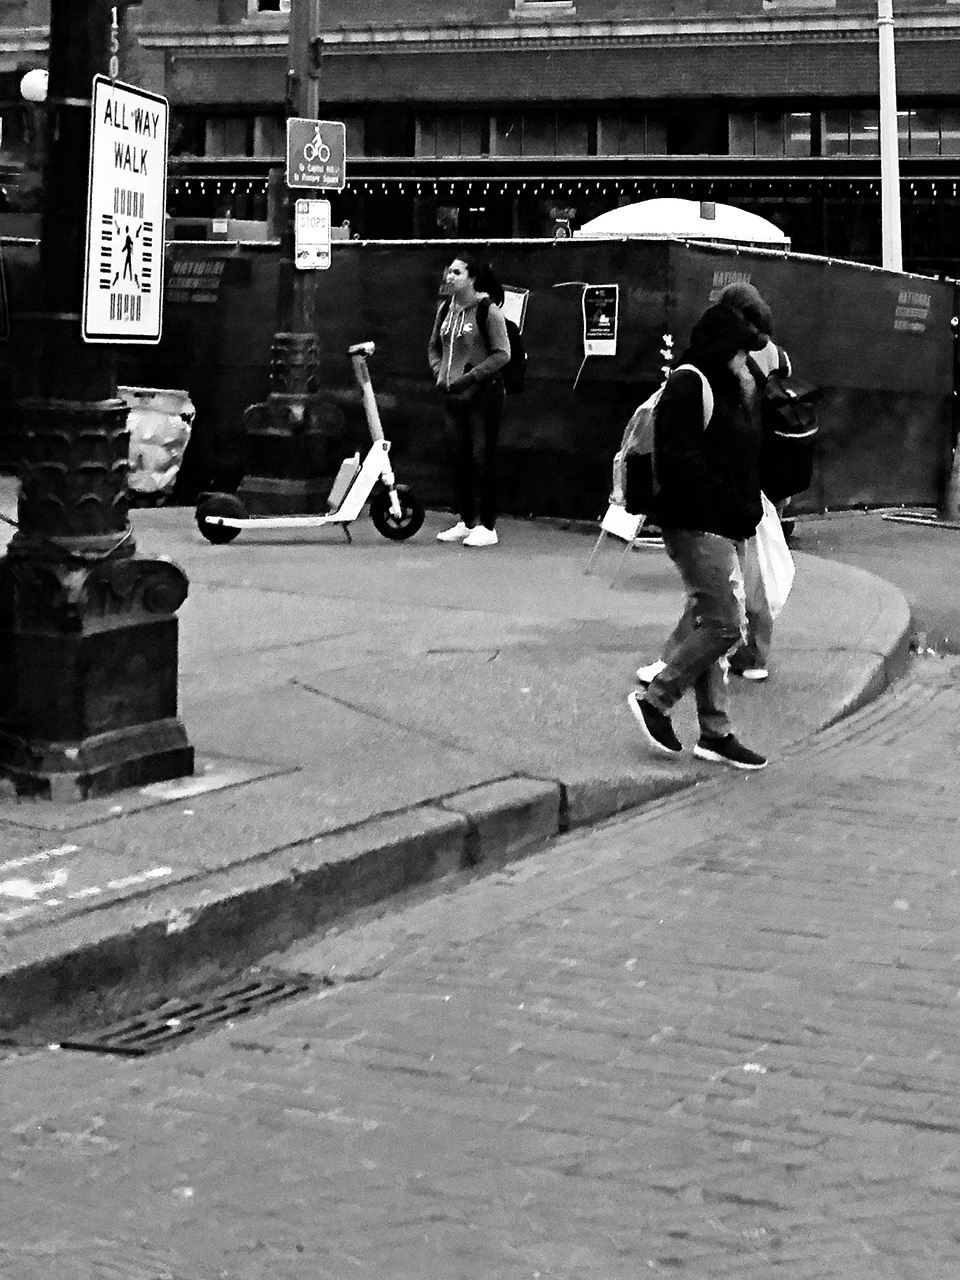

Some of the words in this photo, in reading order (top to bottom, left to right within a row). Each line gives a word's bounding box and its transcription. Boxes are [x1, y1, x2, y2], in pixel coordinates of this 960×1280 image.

[104, 98, 129, 130] ALL
[134, 107, 160, 139] WAY
[114, 141, 148, 176] WALK
